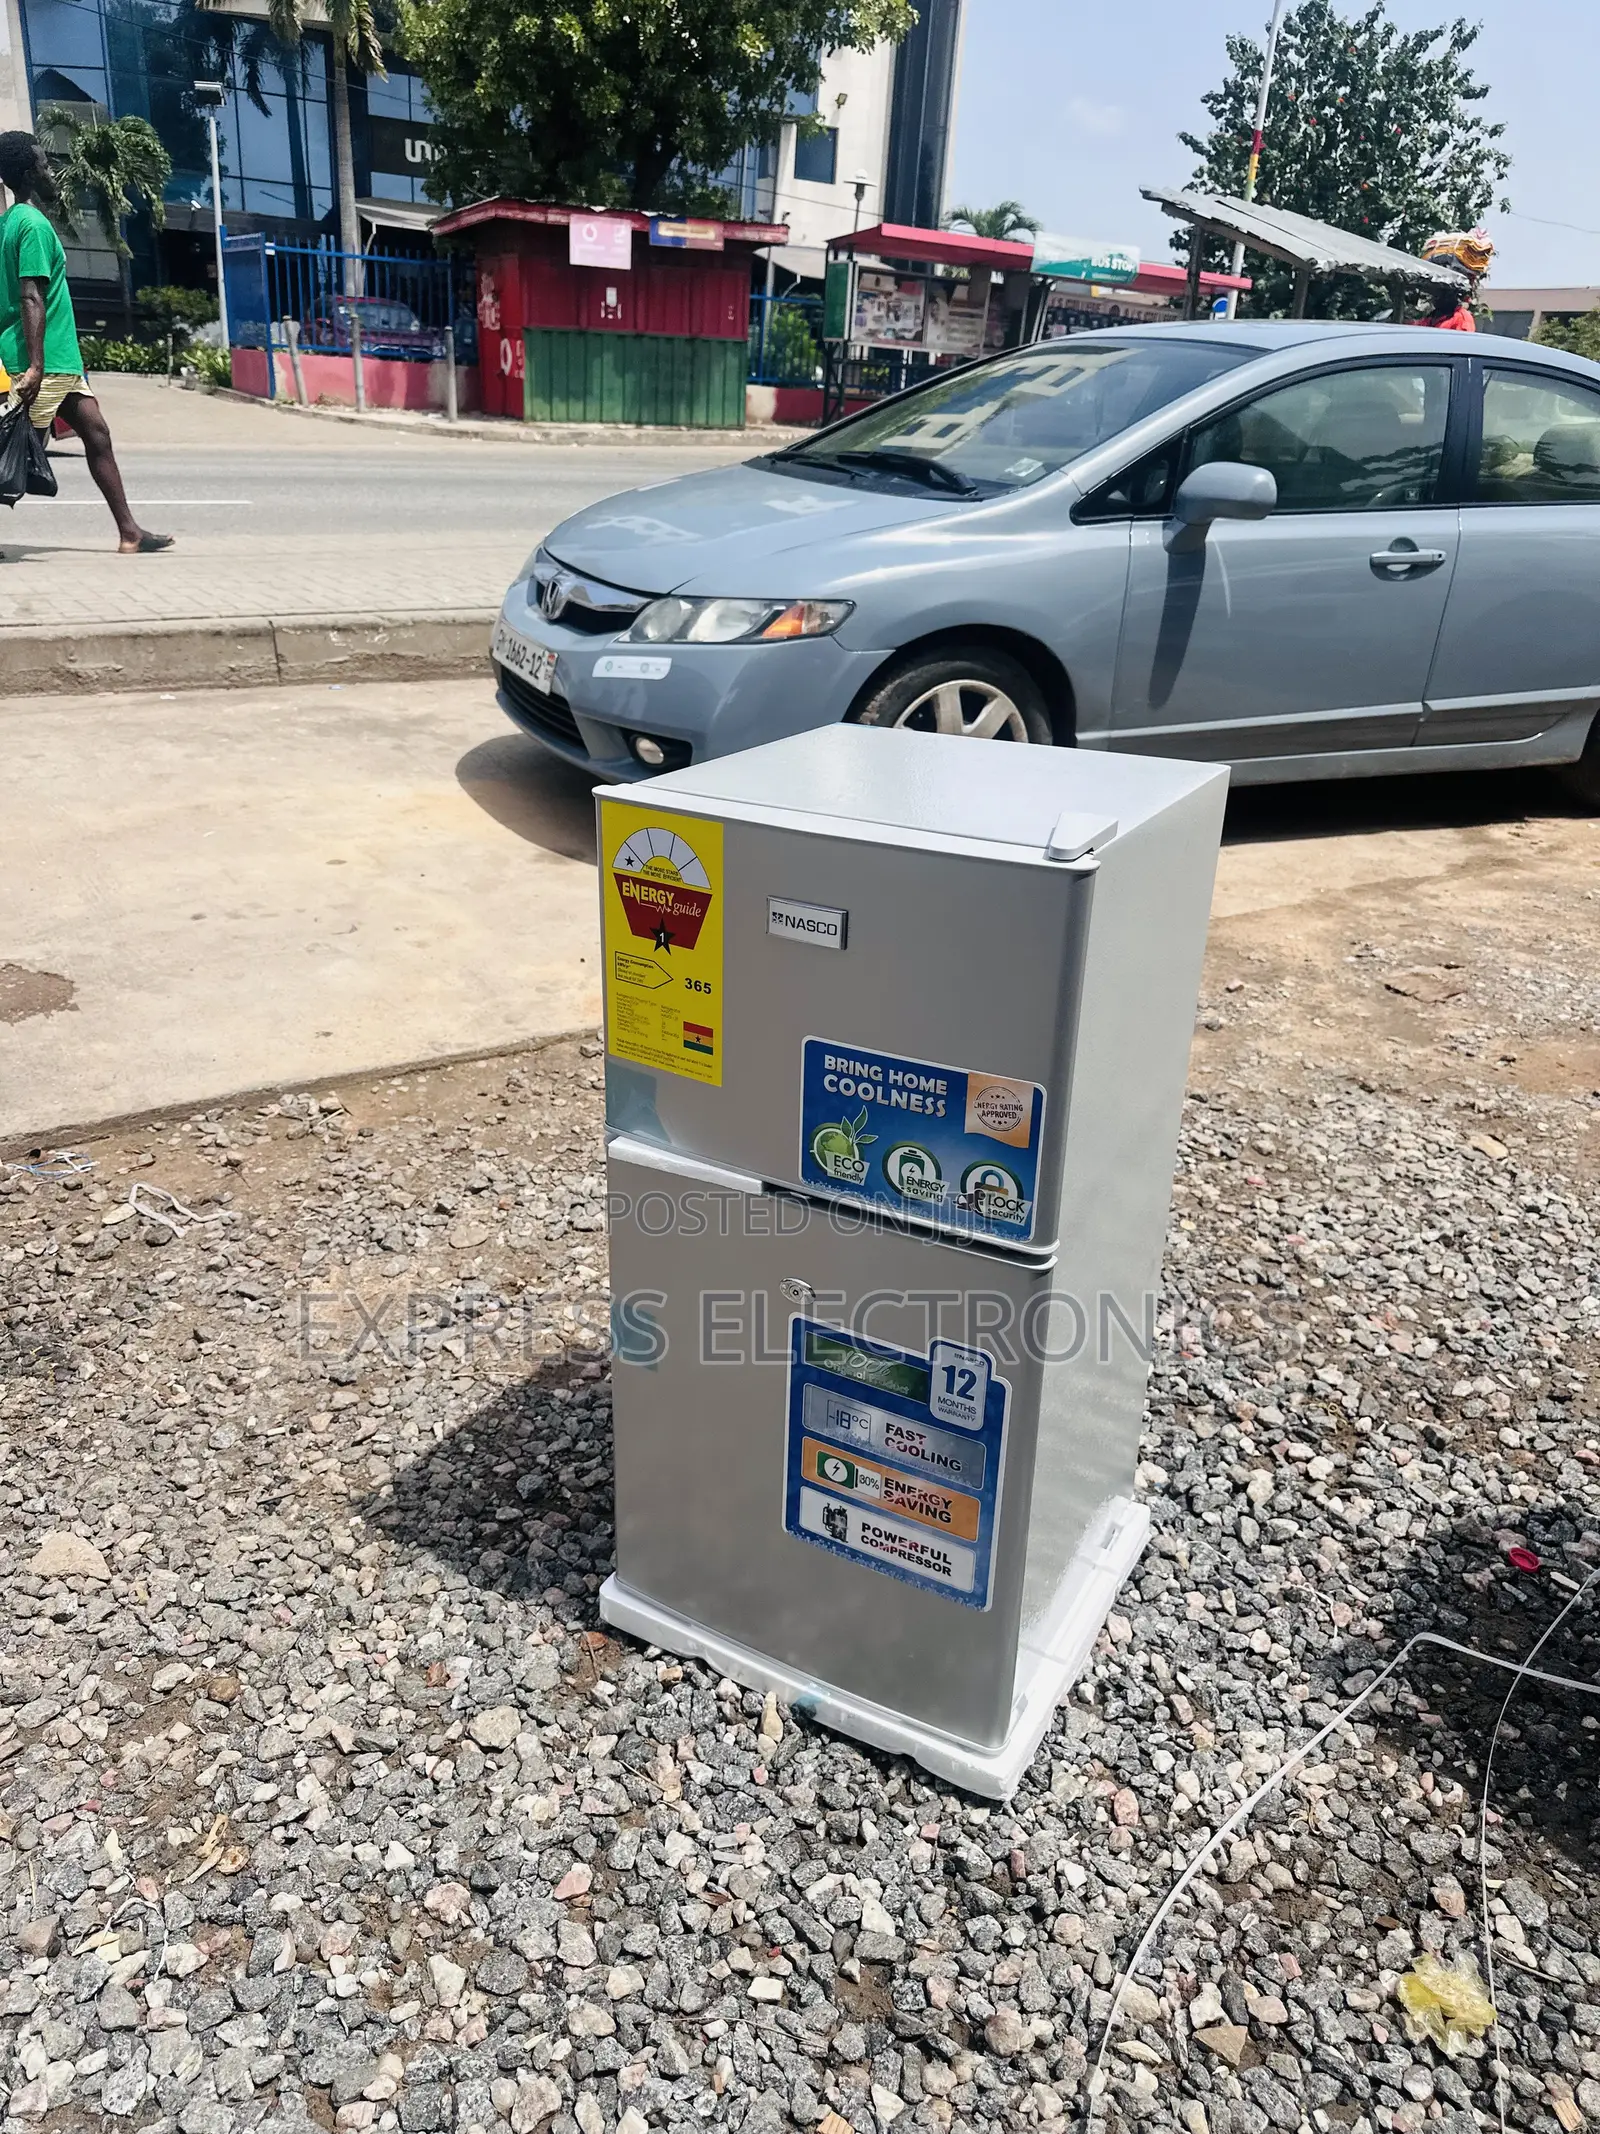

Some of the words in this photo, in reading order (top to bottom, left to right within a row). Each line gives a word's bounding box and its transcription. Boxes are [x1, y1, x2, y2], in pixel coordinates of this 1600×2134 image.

[1091, 256, 1110, 269] BUS
[622, 878, 675, 907] ENERGY
[673, 902, 702, 918] guide
[785, 914, 838, 936] NASCO
[659, 932, 665, 943] 1
[684, 977, 712, 995] 365
[824, 1054, 882, 1081] BRING
[888, 1069, 948, 1096] HOME
[823, 1074, 946, 1118] COOLNESS
[981, 1110, 1017, 1119] APPROVED
[999, 1103, 1023, 1112] RATING
[834, 1155, 865, 1173] ECO
[834, 1168, 864, 1184] friendly
[906, 1176, 945, 1193] ENERGY
[907, 1186, 943, 1203] saving
[988, 1194, 1025, 1213] LOCK
[988, 1208, 1025, 1223] security
[941, 1364, 977, 1402] 12
[937, 1396, 977, 1414] MONTHS
[938, 1406, 976, 1422] WARRANTY
[885, 1422, 927, 1446] FAST
[884, 1436, 961, 1472] COOLING
[884, 1477, 953, 1510] ENERGY
[883, 1489, 952, 1524] SAVING
[861, 1522, 952, 1566] POWERFUL
[860, 1535, 952, 1577] COMPRESSOR
